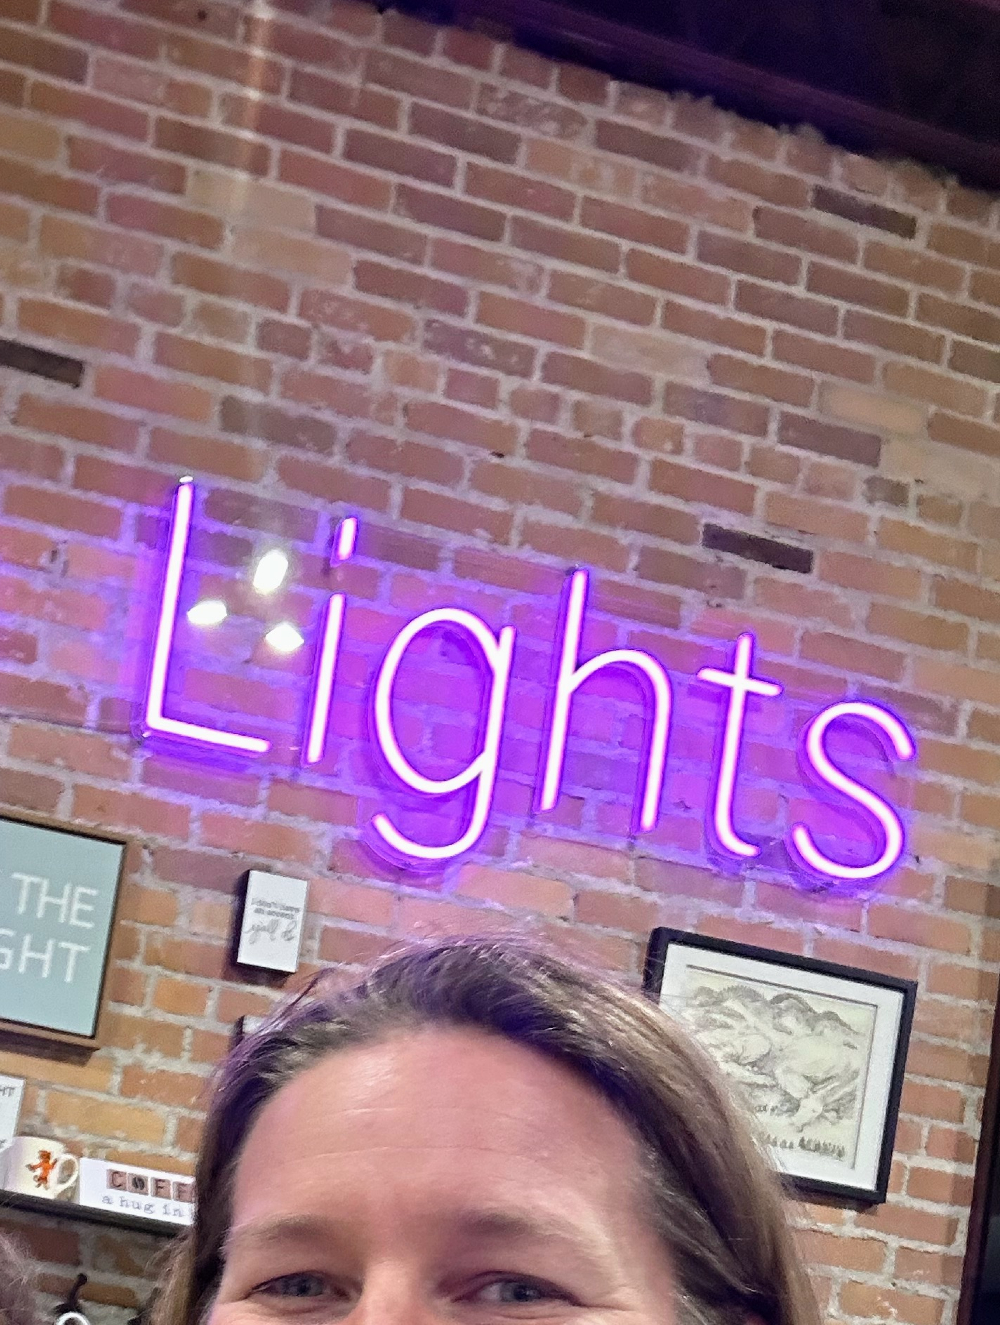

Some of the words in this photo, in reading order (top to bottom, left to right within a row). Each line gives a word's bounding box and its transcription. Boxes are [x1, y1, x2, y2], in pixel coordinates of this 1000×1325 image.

[141, 477, 916, 880] Lights
[11, 871, 99, 930] THE
[101, 1194, 114, 1205] a
[119, 1195, 155, 1215] hug
[162, 1204, 184, 1218] in
[110, 1170, 194, 1200] COFF
